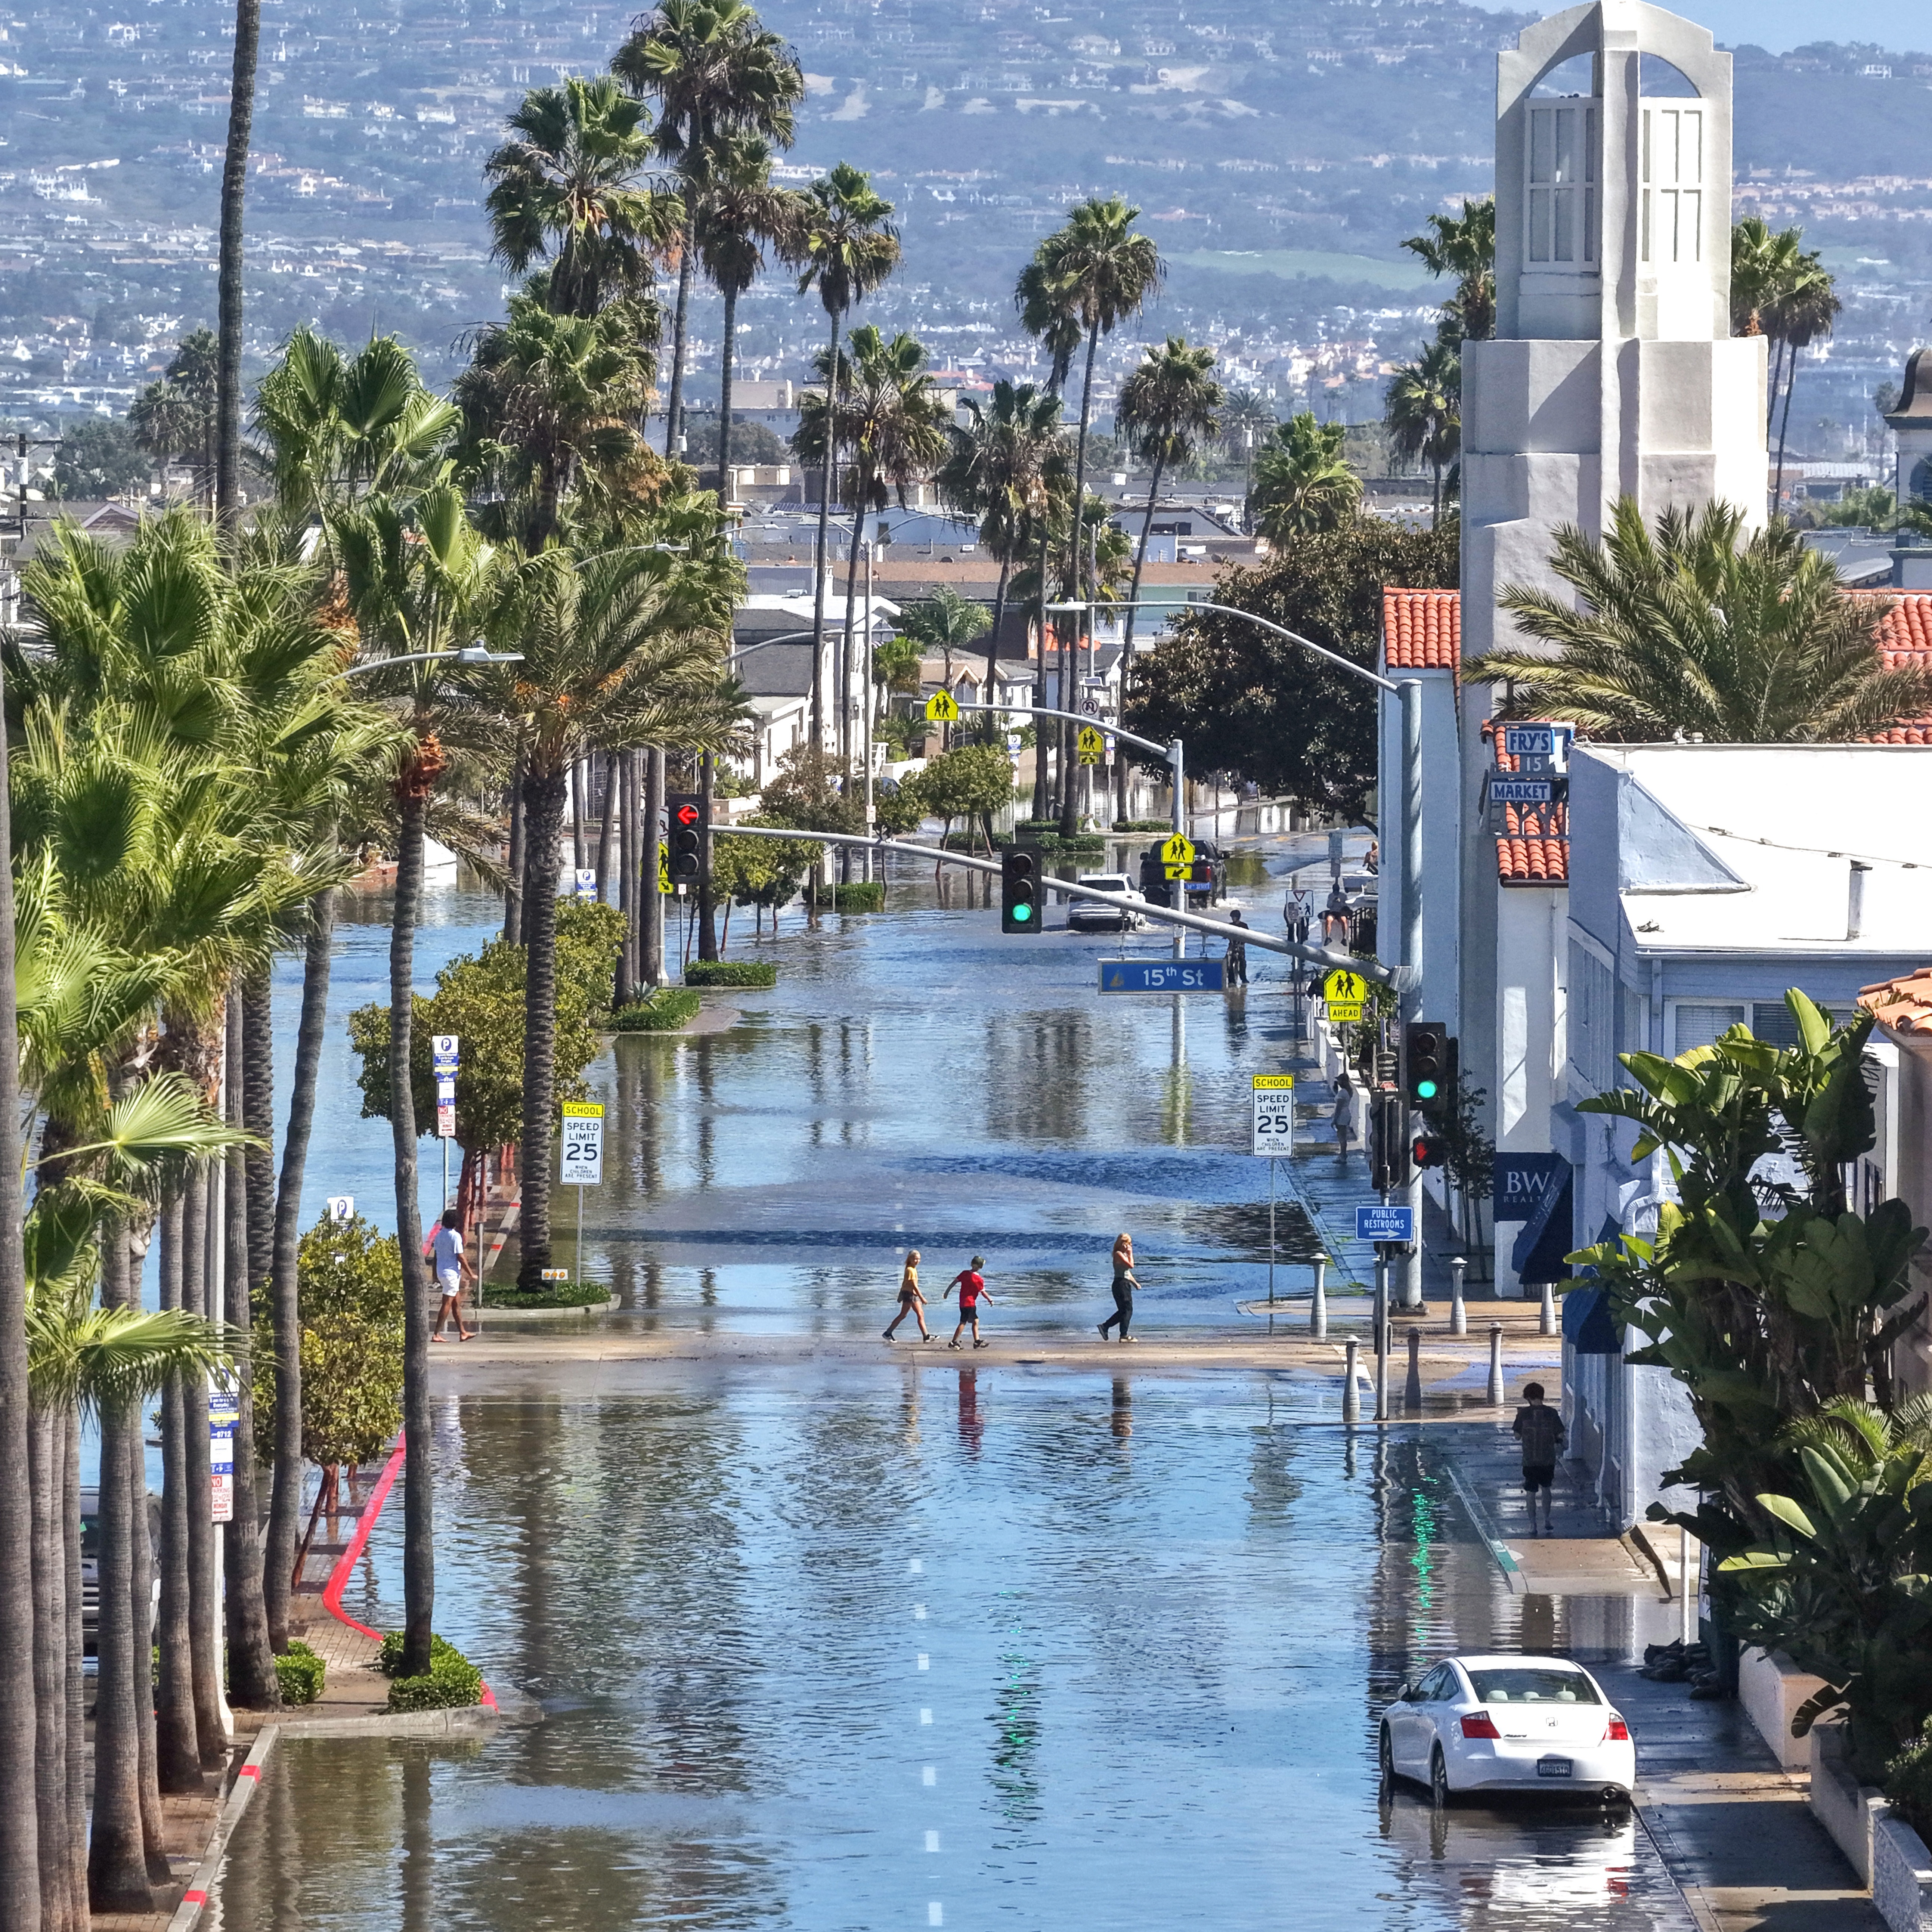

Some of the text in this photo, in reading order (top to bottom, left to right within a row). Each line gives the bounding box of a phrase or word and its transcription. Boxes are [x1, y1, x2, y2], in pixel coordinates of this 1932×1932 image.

[1510, 733, 1549, 751] FRY'S
[1527, 757, 1542, 771] 15
[1494, 784, 1547, 799] MARKET
[1143, 967, 1204, 986] 15th St
[566, 1106, 601, 1115] SCHOOL
[567, 1123, 599, 1131] SPEED
[1257, 1115, 1288, 1133] 25
[566, 1143, 597, 1161] 25
[1505, 1171, 1551, 1193] BW
[1372, 1210, 1397, 1219] PUBLIC
[1364, 1219, 1405, 1229] RESTROOMS
